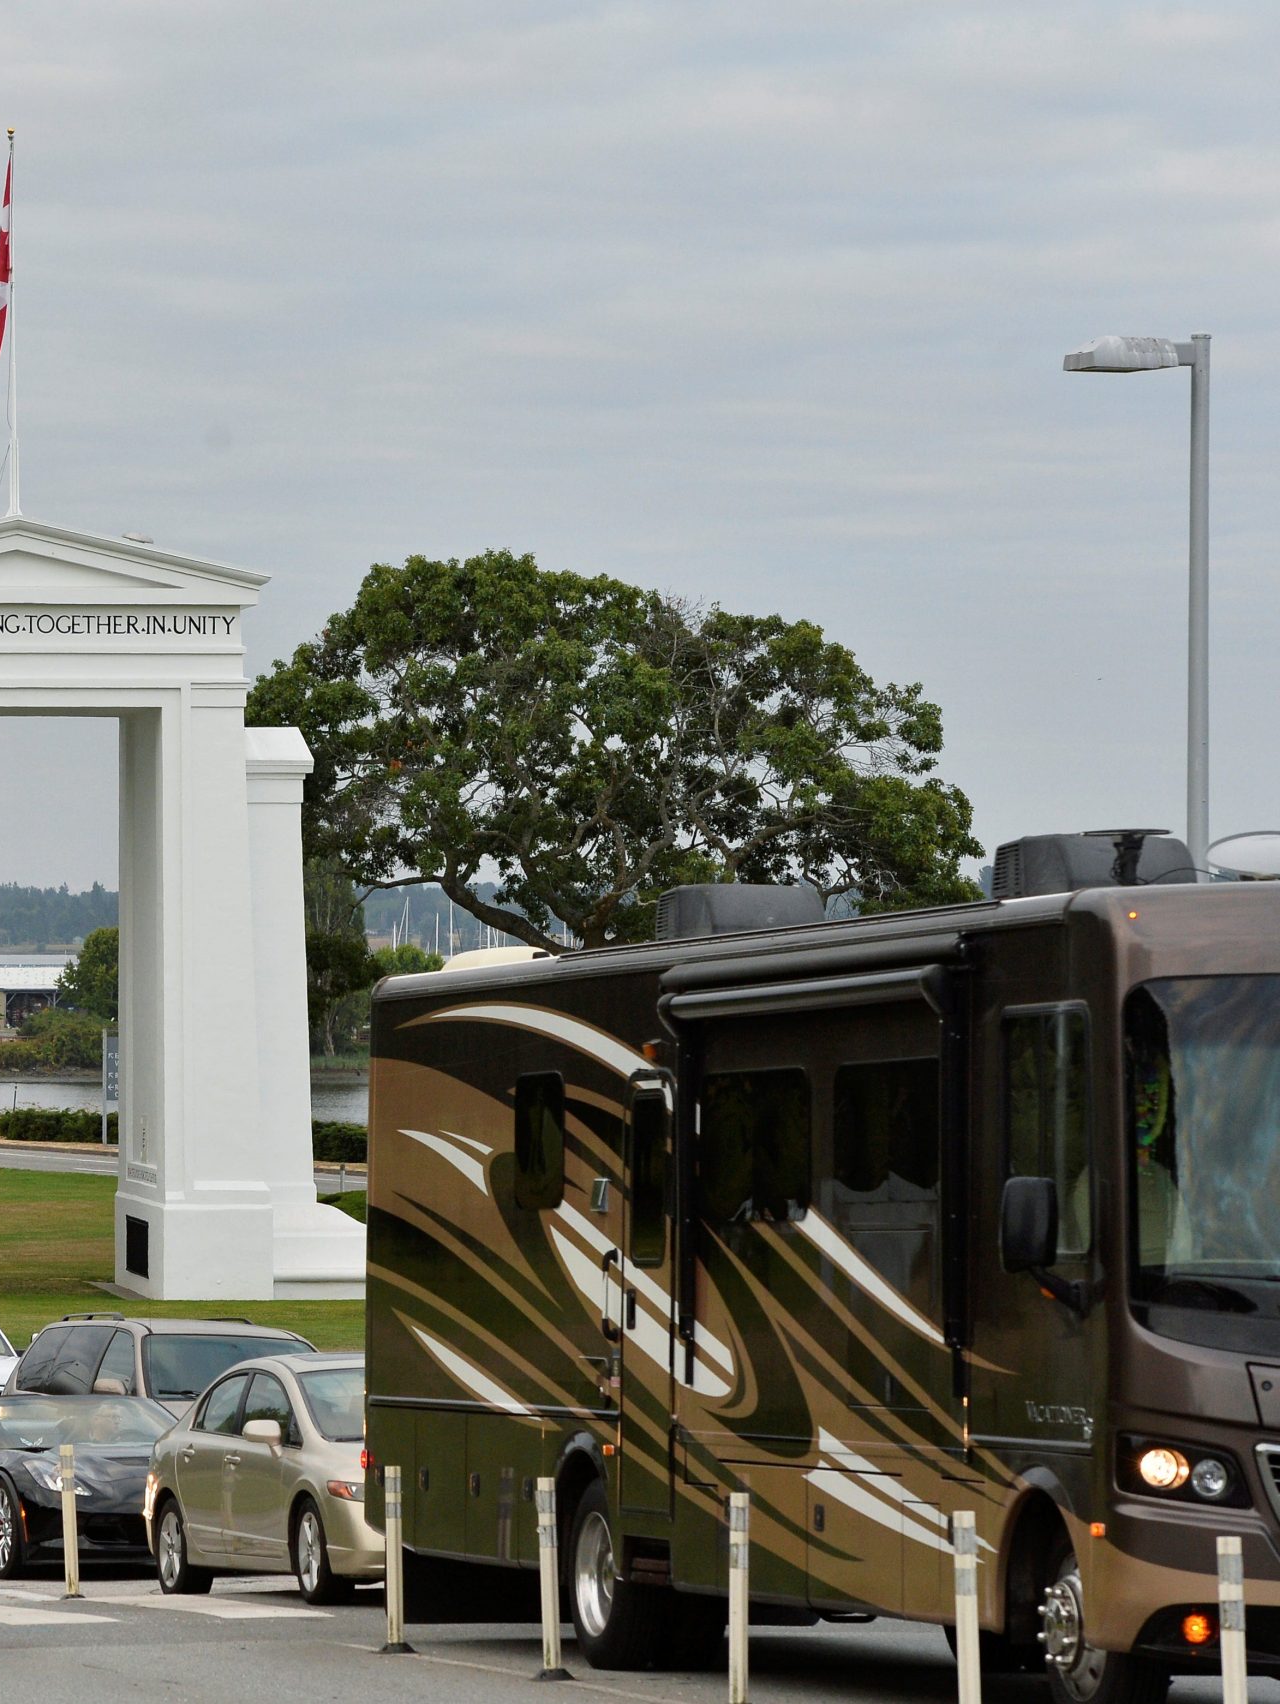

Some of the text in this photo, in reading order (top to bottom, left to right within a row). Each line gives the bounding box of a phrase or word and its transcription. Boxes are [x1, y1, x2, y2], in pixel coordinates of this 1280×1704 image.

[24, 614, 141, 634] TOGETHER
[146, 615, 166, 635] IN
[173, 615, 236, 635] UNITY
